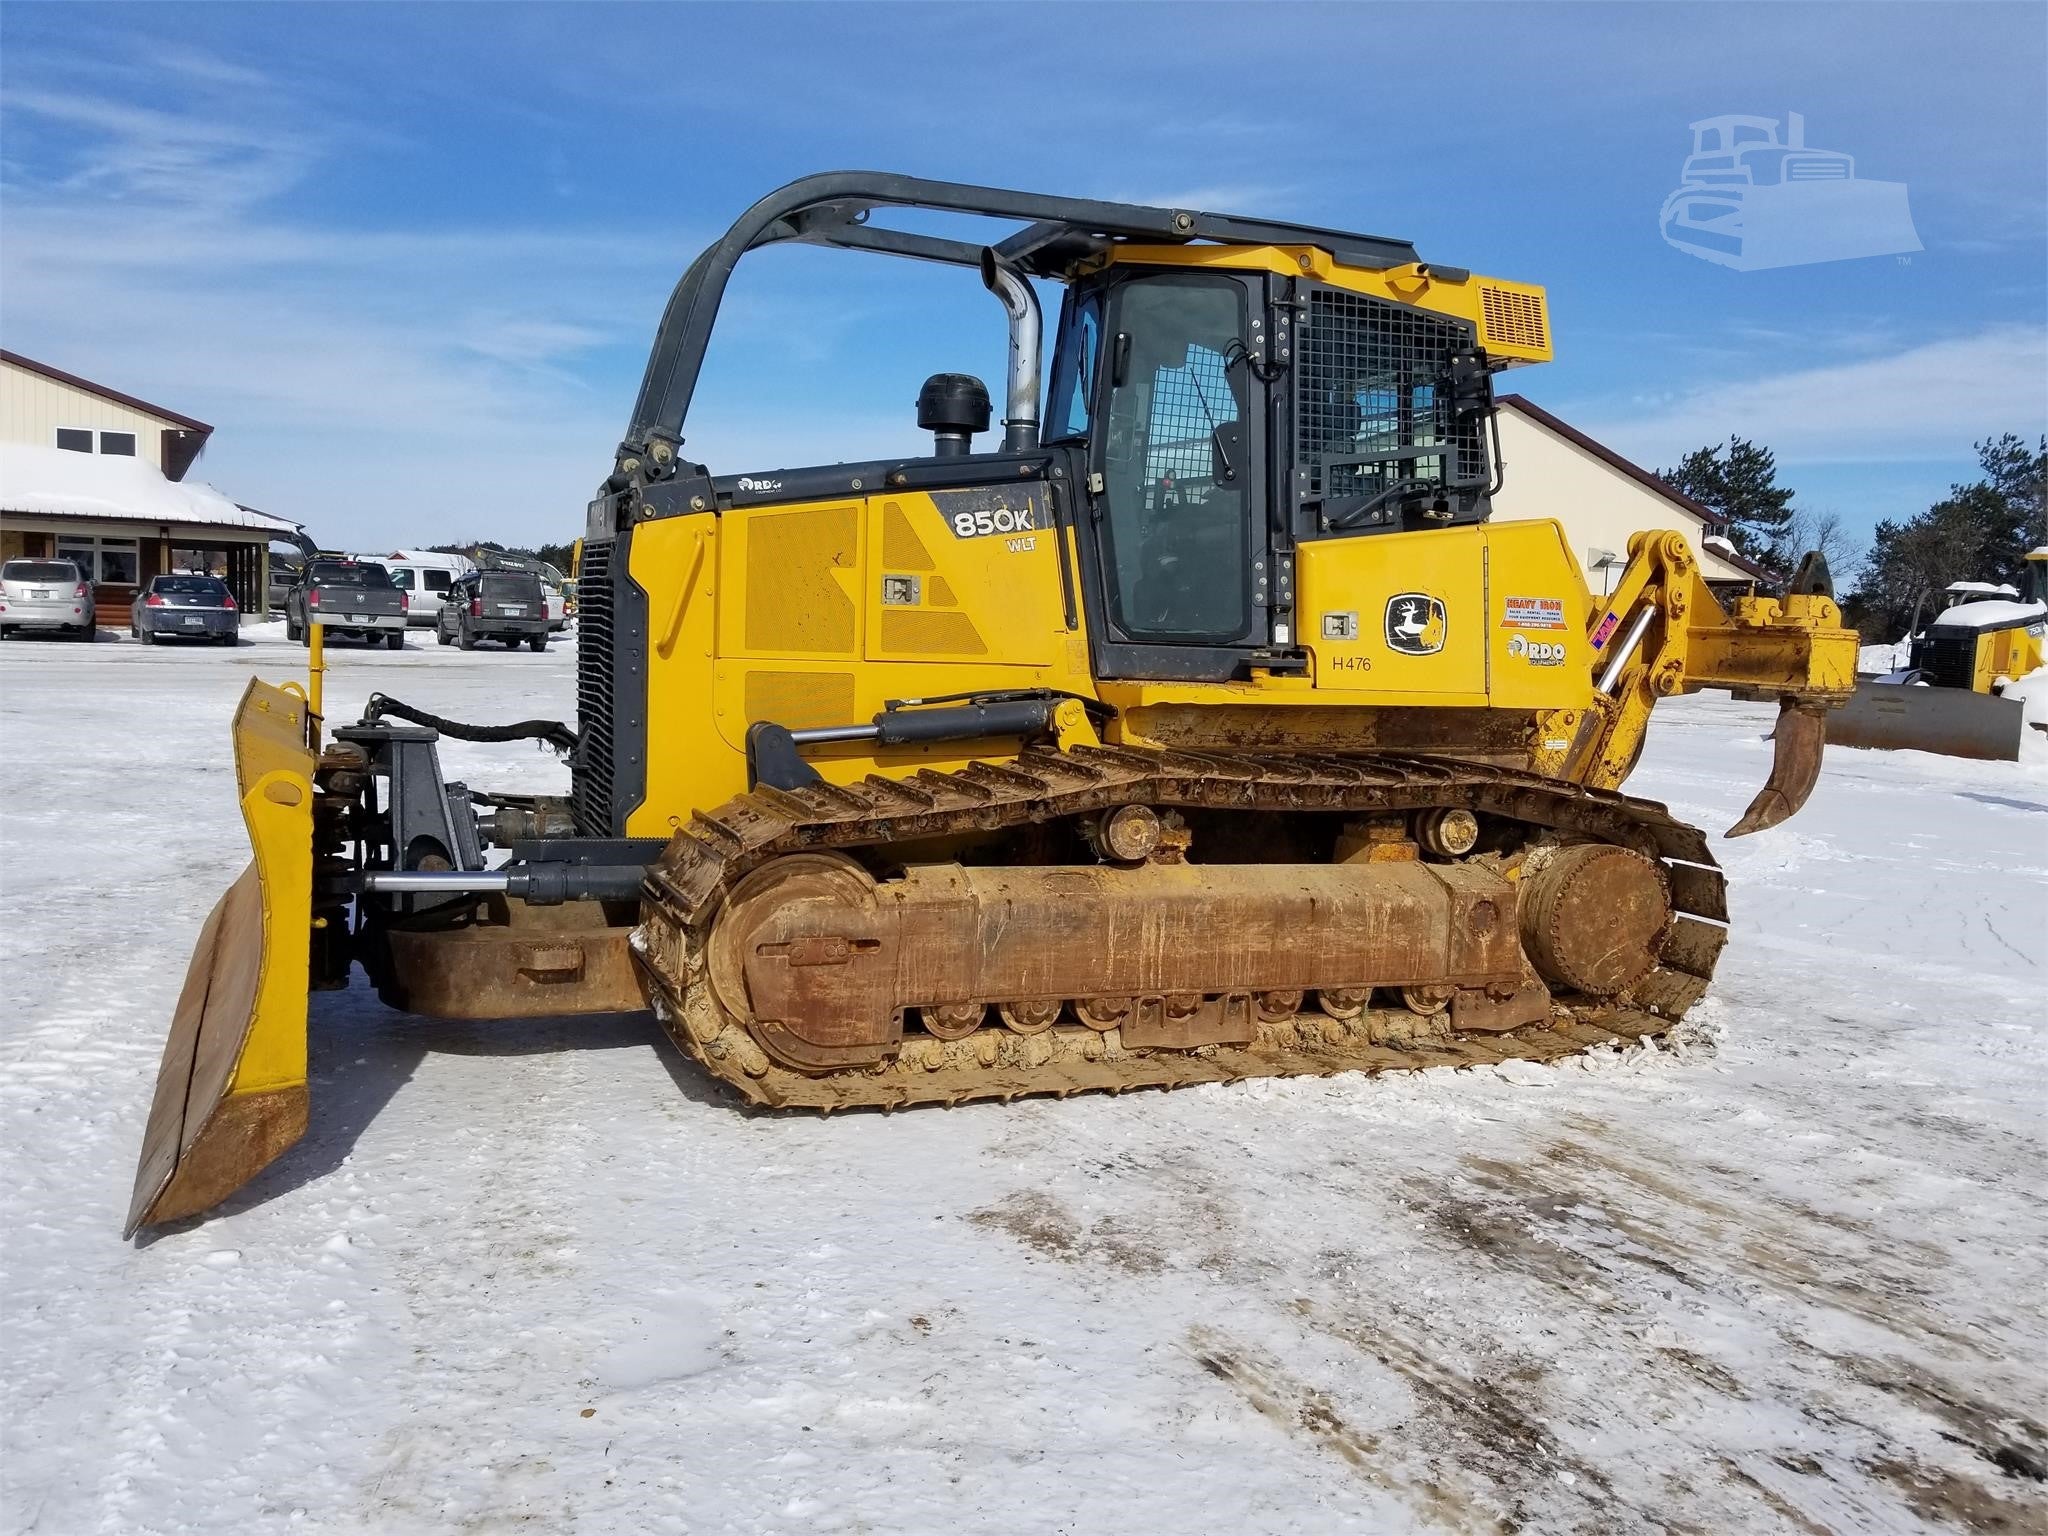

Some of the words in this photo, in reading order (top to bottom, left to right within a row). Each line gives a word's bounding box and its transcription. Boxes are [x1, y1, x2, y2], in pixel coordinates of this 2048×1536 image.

[954, 509, 1033, 537] 850K
[1006, 537, 1036, 553] WLT
[500, 560, 525, 568] VOLVO
[1507, 599, 1536, 609] HEAVY
[1540, 600, 1561, 611] IRON
